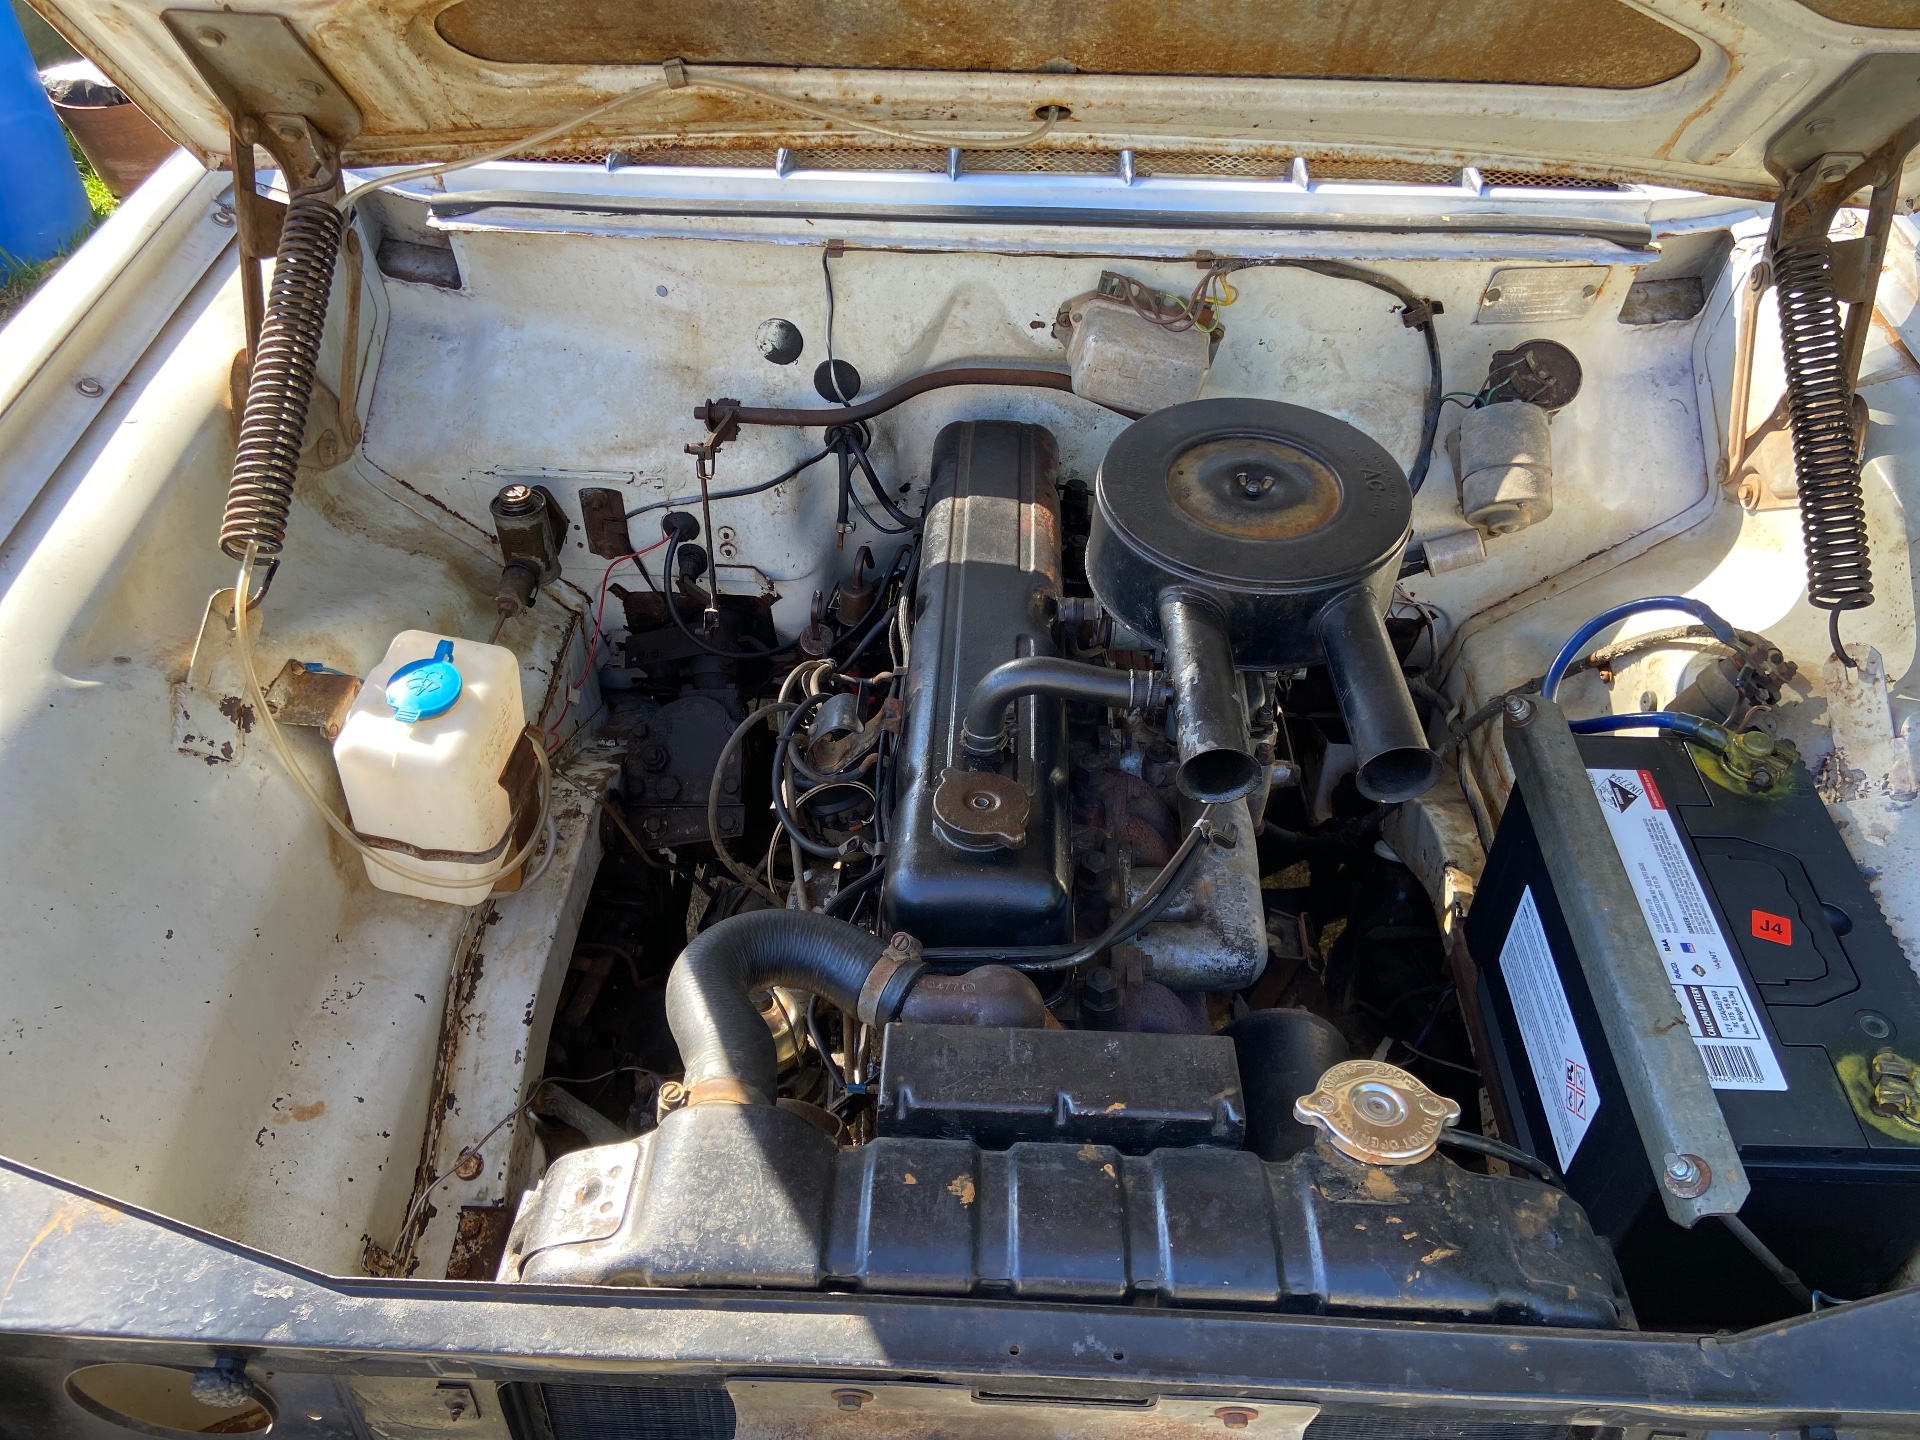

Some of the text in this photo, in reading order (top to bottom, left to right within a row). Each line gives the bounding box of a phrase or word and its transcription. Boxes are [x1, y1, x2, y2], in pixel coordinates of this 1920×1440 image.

[1360, 469, 1386, 491] AC
[1610, 773, 1644, 796] UN2794
[1760, 919, 1783, 936] J4
[1661, 939, 1671, 951] RAA
[1670, 962, 1682, 979] RACQ
[1689, 986, 1717, 1036] CALCIUM BATTERY
[1734, 1007, 1745, 1021] Weight
[1724, 1023, 1734, 1033] 12V
[1376, 1063, 1427, 1097] REMOVE
[1360, 1117, 1438, 1151] DO NOT OPEN
